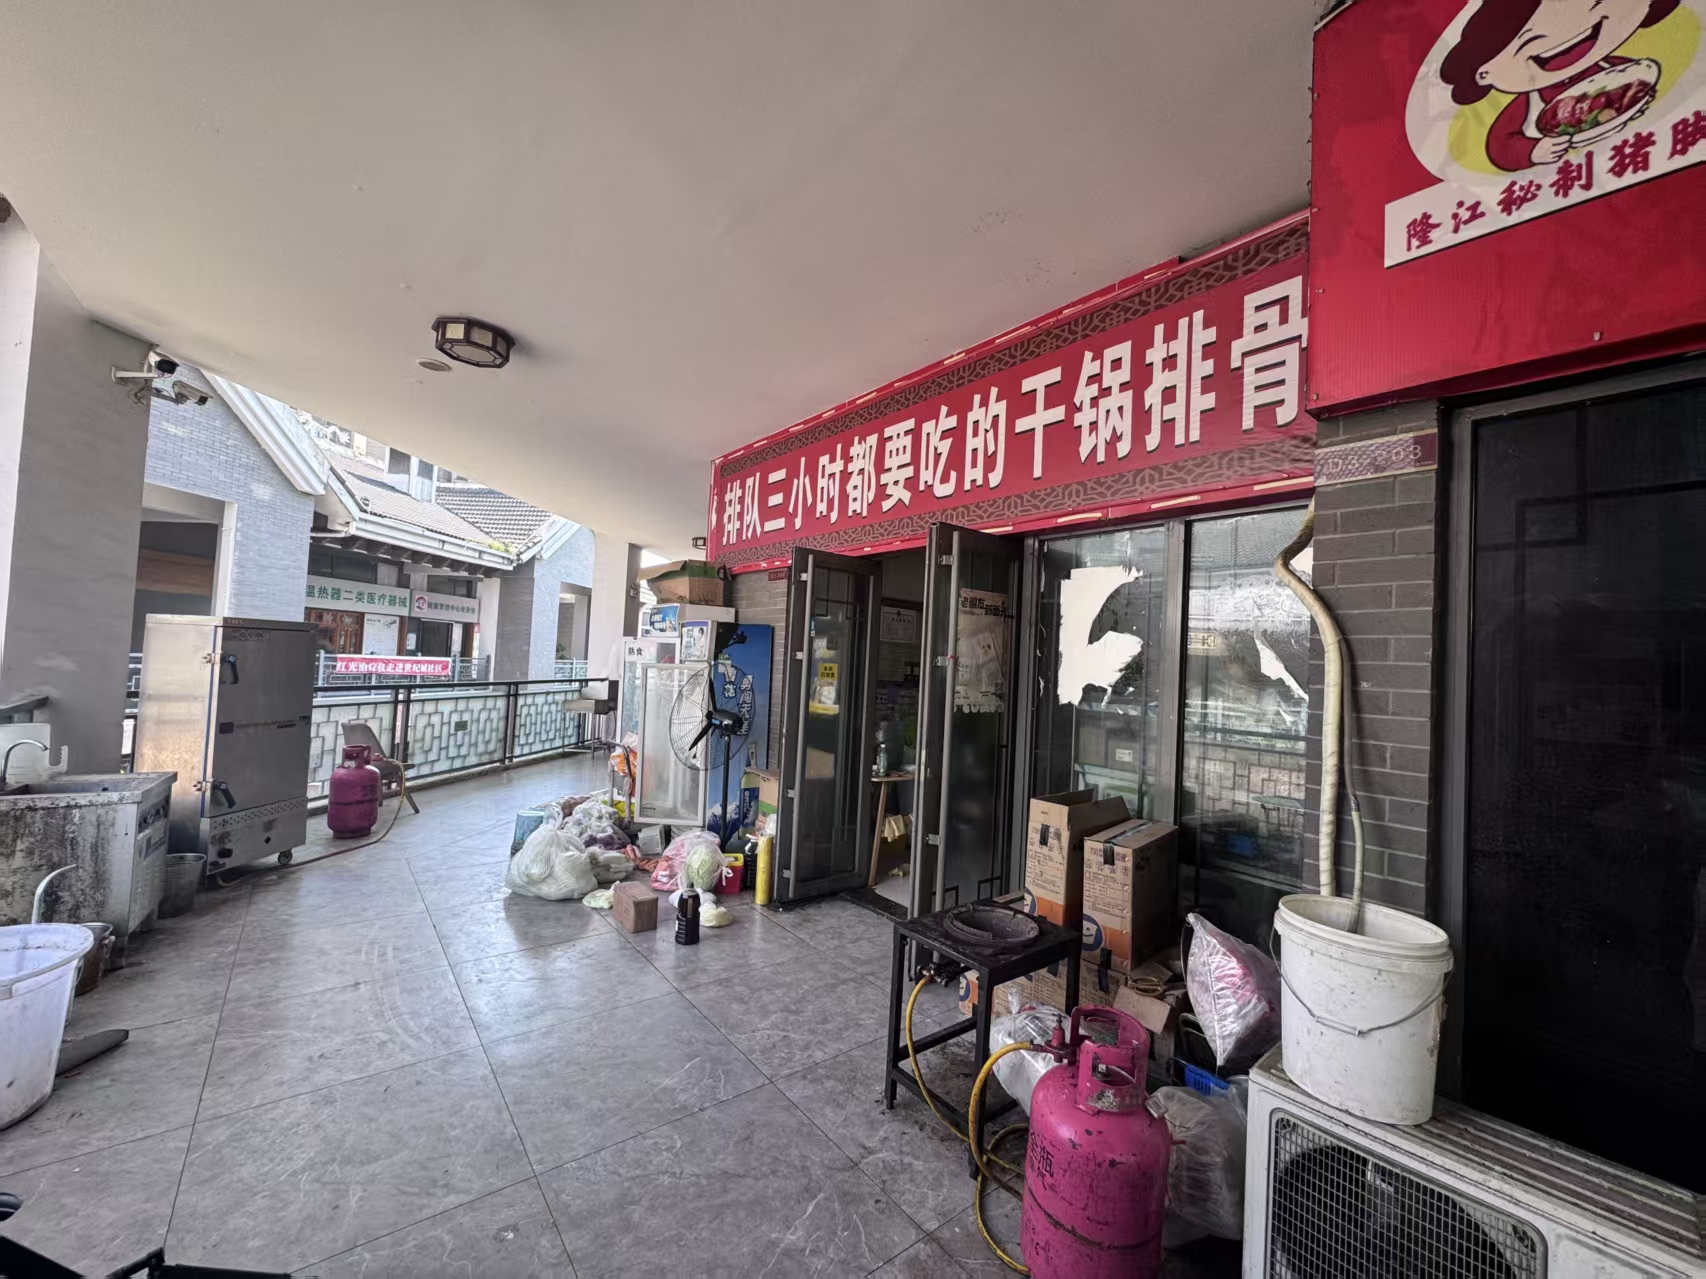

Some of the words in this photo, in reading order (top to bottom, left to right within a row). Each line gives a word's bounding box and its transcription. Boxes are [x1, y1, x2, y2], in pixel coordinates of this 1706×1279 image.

[721, 274, 1309, 547] 排队三小时都要吃的干锅排骨
[628, 646, 643, 656] 熟食
